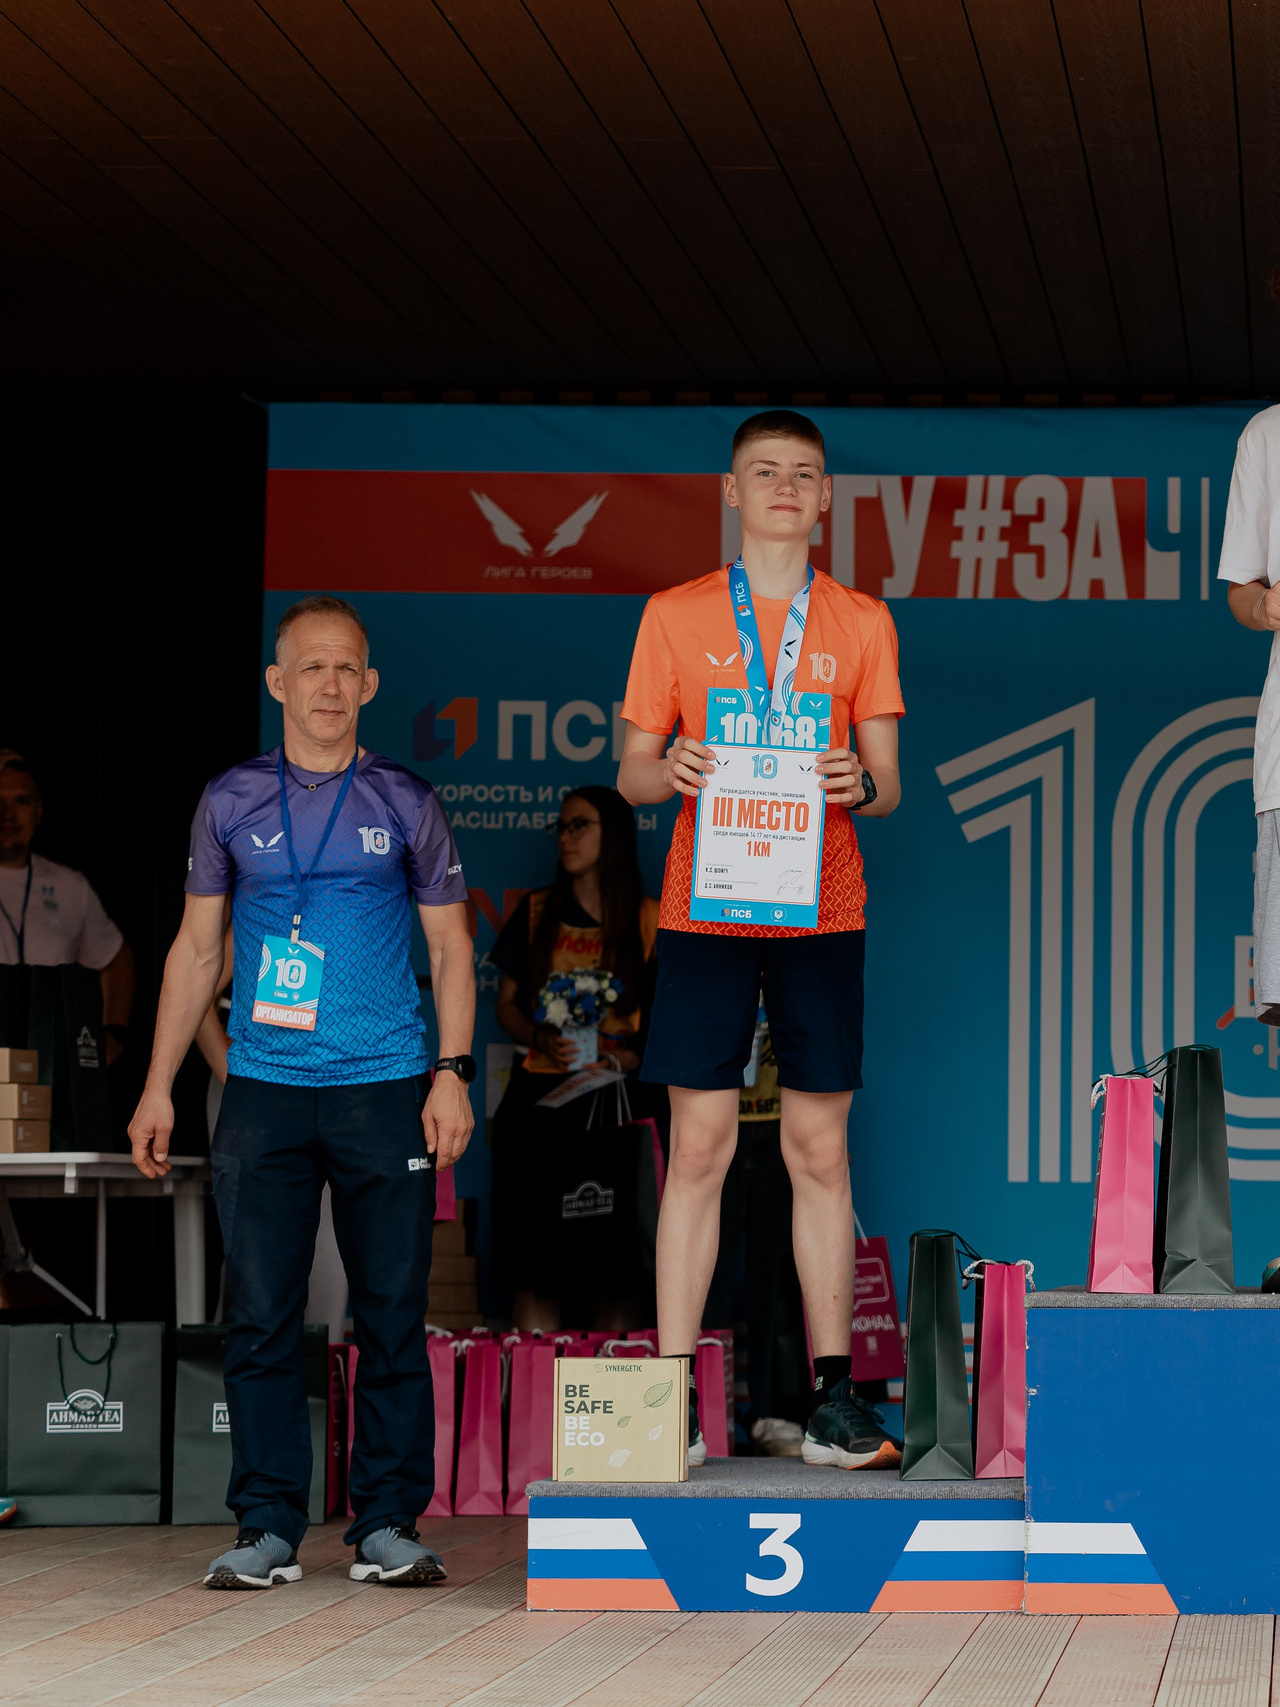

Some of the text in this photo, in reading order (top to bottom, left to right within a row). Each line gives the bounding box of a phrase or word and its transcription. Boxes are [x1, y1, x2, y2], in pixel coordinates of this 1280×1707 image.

[721, 475, 937, 600] ГУ
[530, 566, 593, 580] ГЕРОЕВ
[735, 581, 746, 603] ПСБ
[808, 652, 837, 684] 10
[720, 713, 817, 749] 1068
[751, 753, 779, 780] 10
[537, 785, 554, 803] И
[712, 796, 810, 833] III МЕСТО
[358, 826, 391, 855] 10
[753, 841, 771, 858] КМ
[730, 909, 752, 919] ПСБ
[274, 957, 307, 990] 10
[255, 1004, 314, 1026] ОРГАНИЗАТОР
[604, 1364, 643, 1373] SYNERGETIC
[564, 1384, 590, 1398] BE
[98, 1409, 120, 1424] TEA
[564, 1400, 614, 1414] SAFE
[564, 1416, 591, 1431] BE
[564, 1432, 605, 1447] ECO
[745, 1513, 804, 1597] 3
